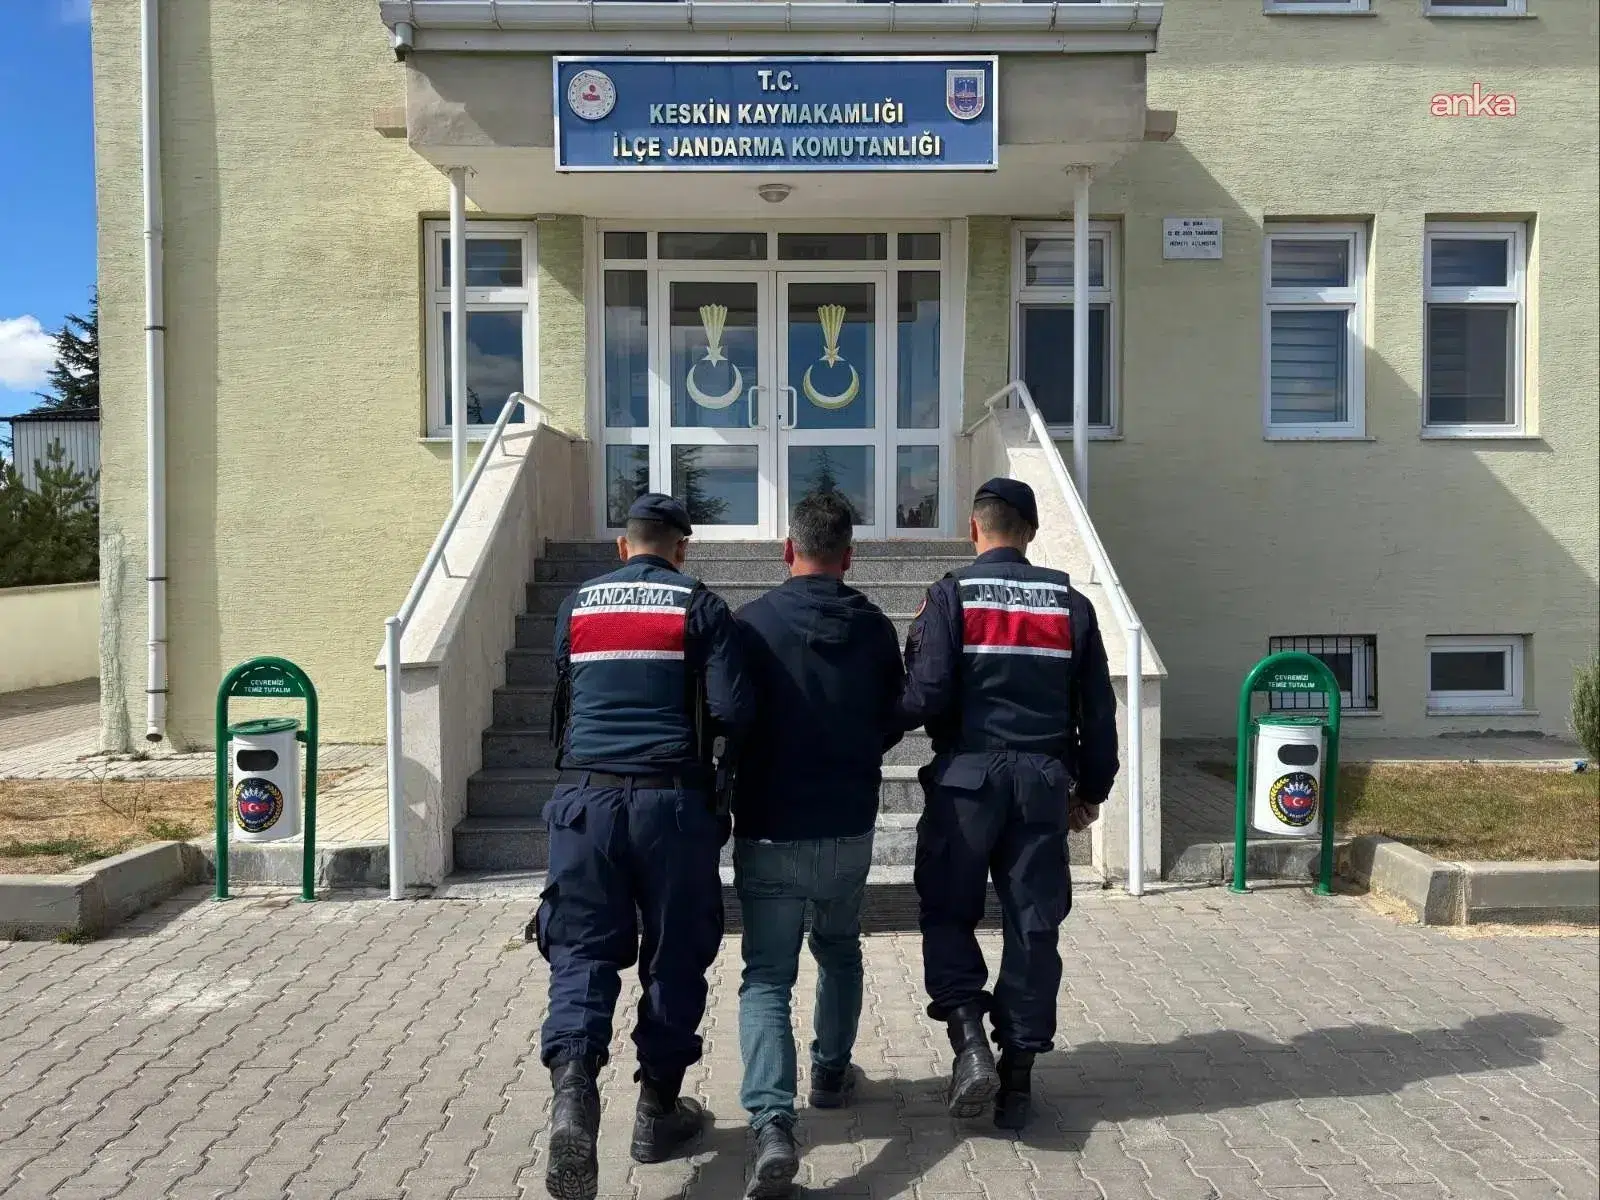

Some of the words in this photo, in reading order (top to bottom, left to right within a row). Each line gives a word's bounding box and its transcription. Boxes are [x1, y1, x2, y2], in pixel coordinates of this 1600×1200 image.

[757, 70, 799, 91] T.C.
[650, 98, 730, 124] KESKİN
[738, 97, 904, 124] KAYMAKAMLIĞI
[613, 131, 661, 162] İLÇE
[668, 136, 785, 157] JANDARMA
[792, 130, 941, 157] KOMUTANLIĞI
[580, 587, 675, 607] JANDARMA
[974, 584, 1060, 608] JANDARMA
[1288, 681, 1316, 689] TUTALIM
